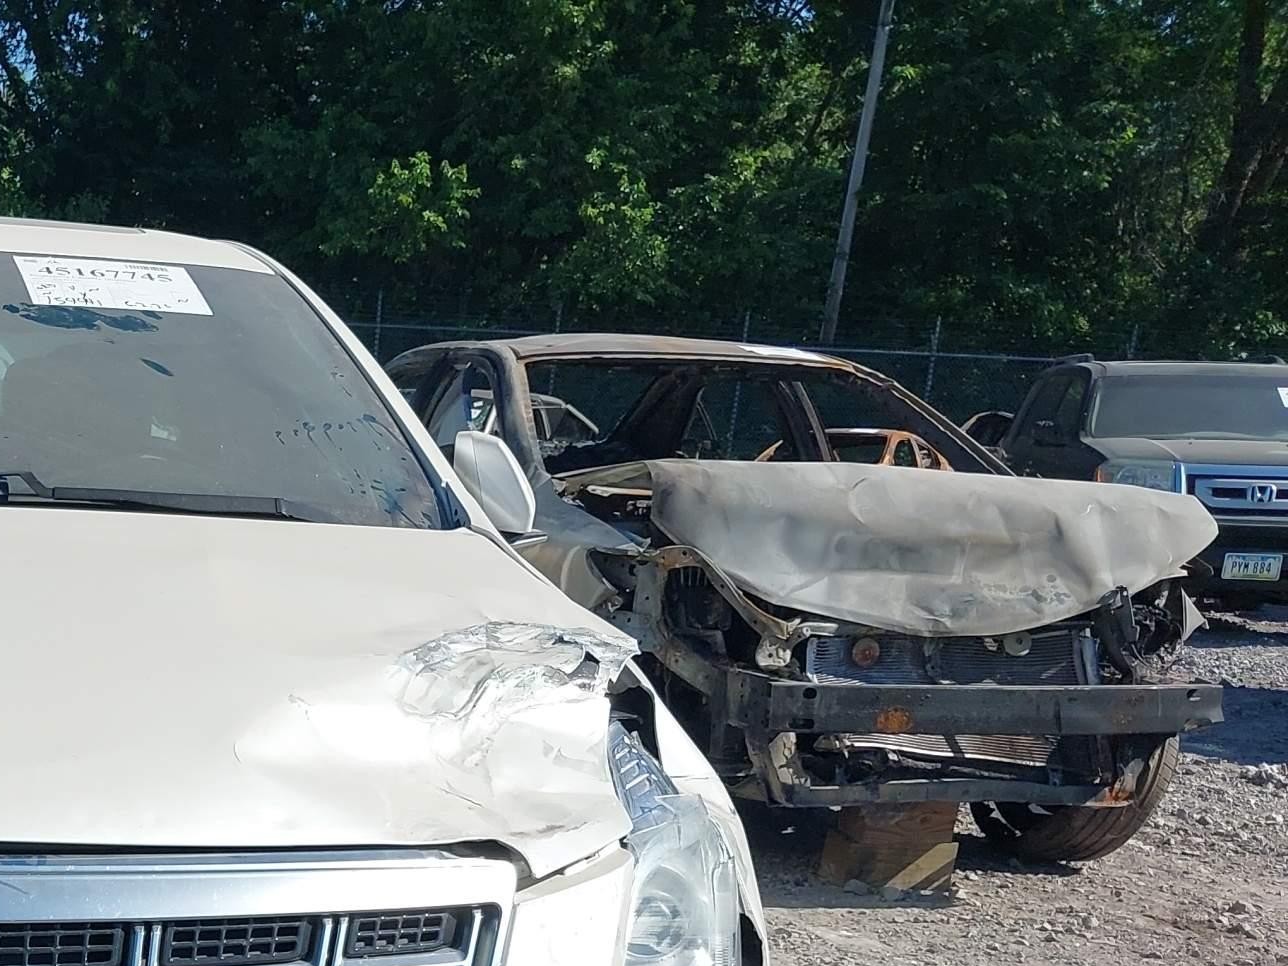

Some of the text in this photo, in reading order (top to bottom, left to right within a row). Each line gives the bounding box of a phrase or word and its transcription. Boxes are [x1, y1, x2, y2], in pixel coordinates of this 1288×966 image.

[37, 265, 174, 282] 45167745
[1231, 560, 1272, 574] PYM 884
